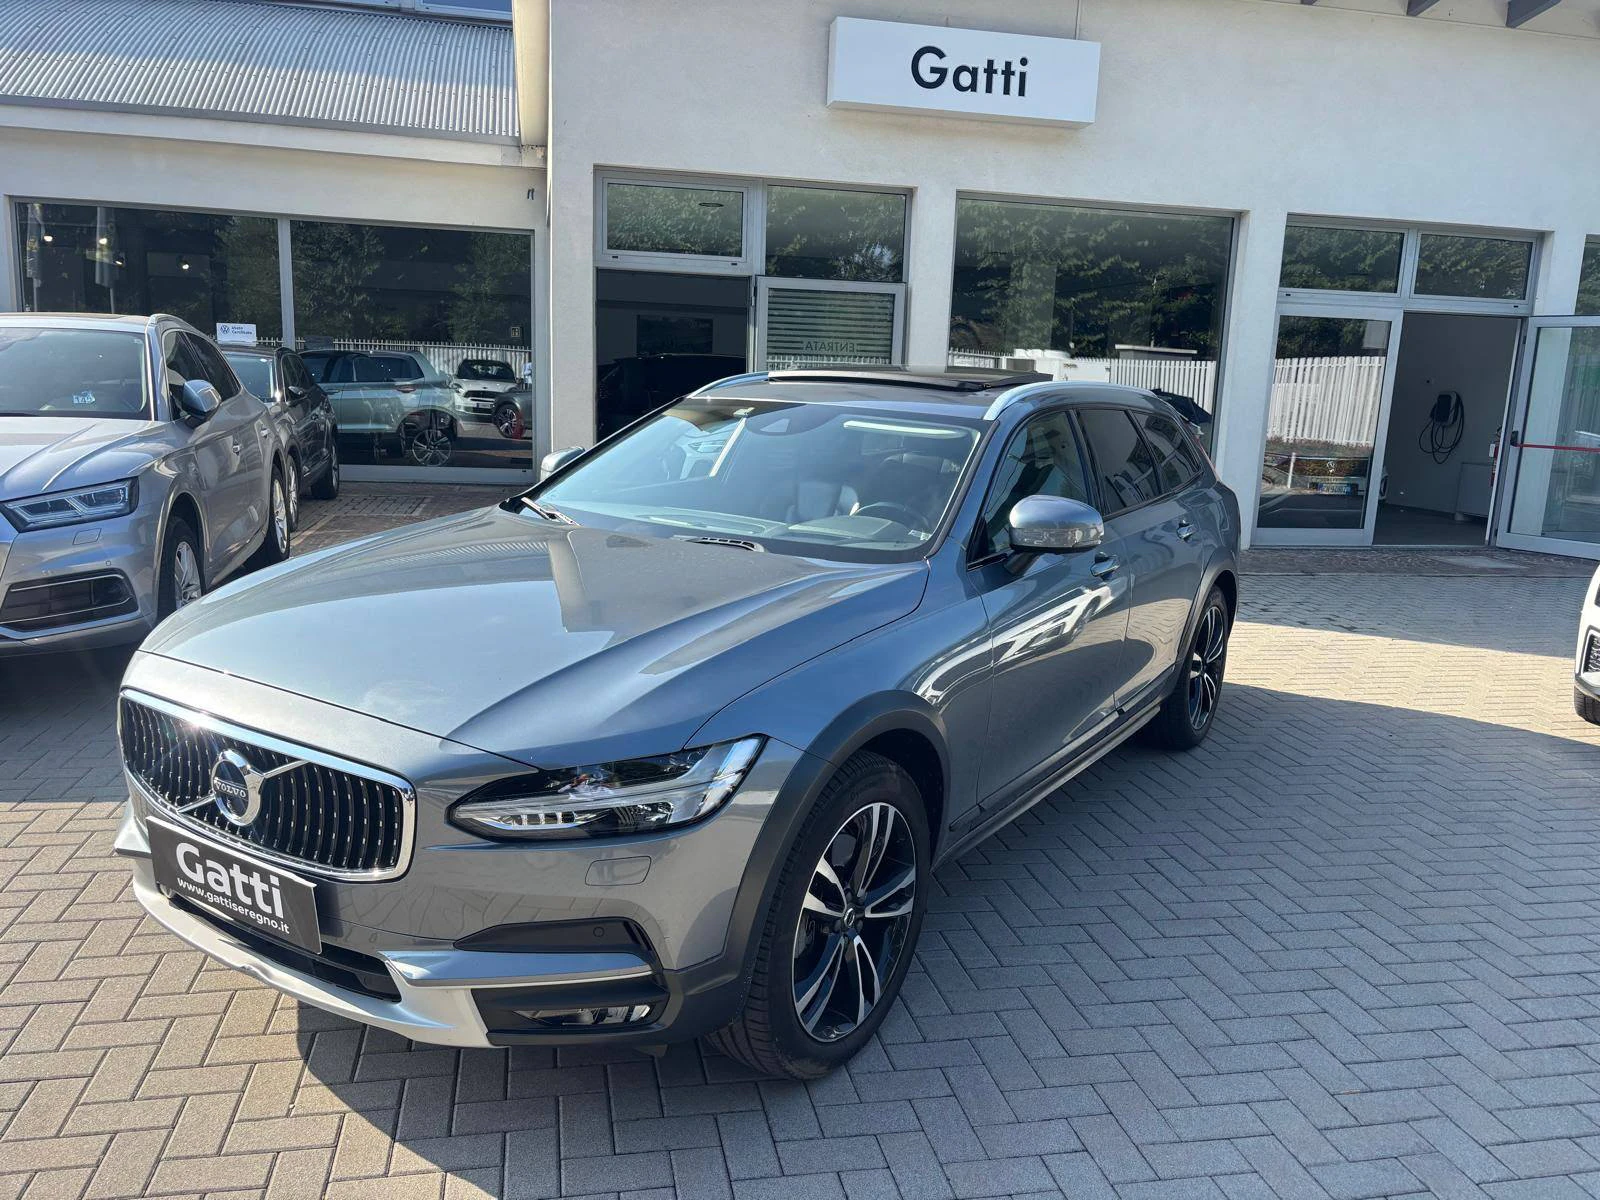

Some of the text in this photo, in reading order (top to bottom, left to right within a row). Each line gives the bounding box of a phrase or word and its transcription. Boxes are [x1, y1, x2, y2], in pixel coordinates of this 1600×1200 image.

[911, 45, 1028, 97] Gatti
[214, 781, 247, 799] VOLVO
[176, 842, 285, 919] Gatti
[177, 877, 290, 935] www.gattiseregno.it
